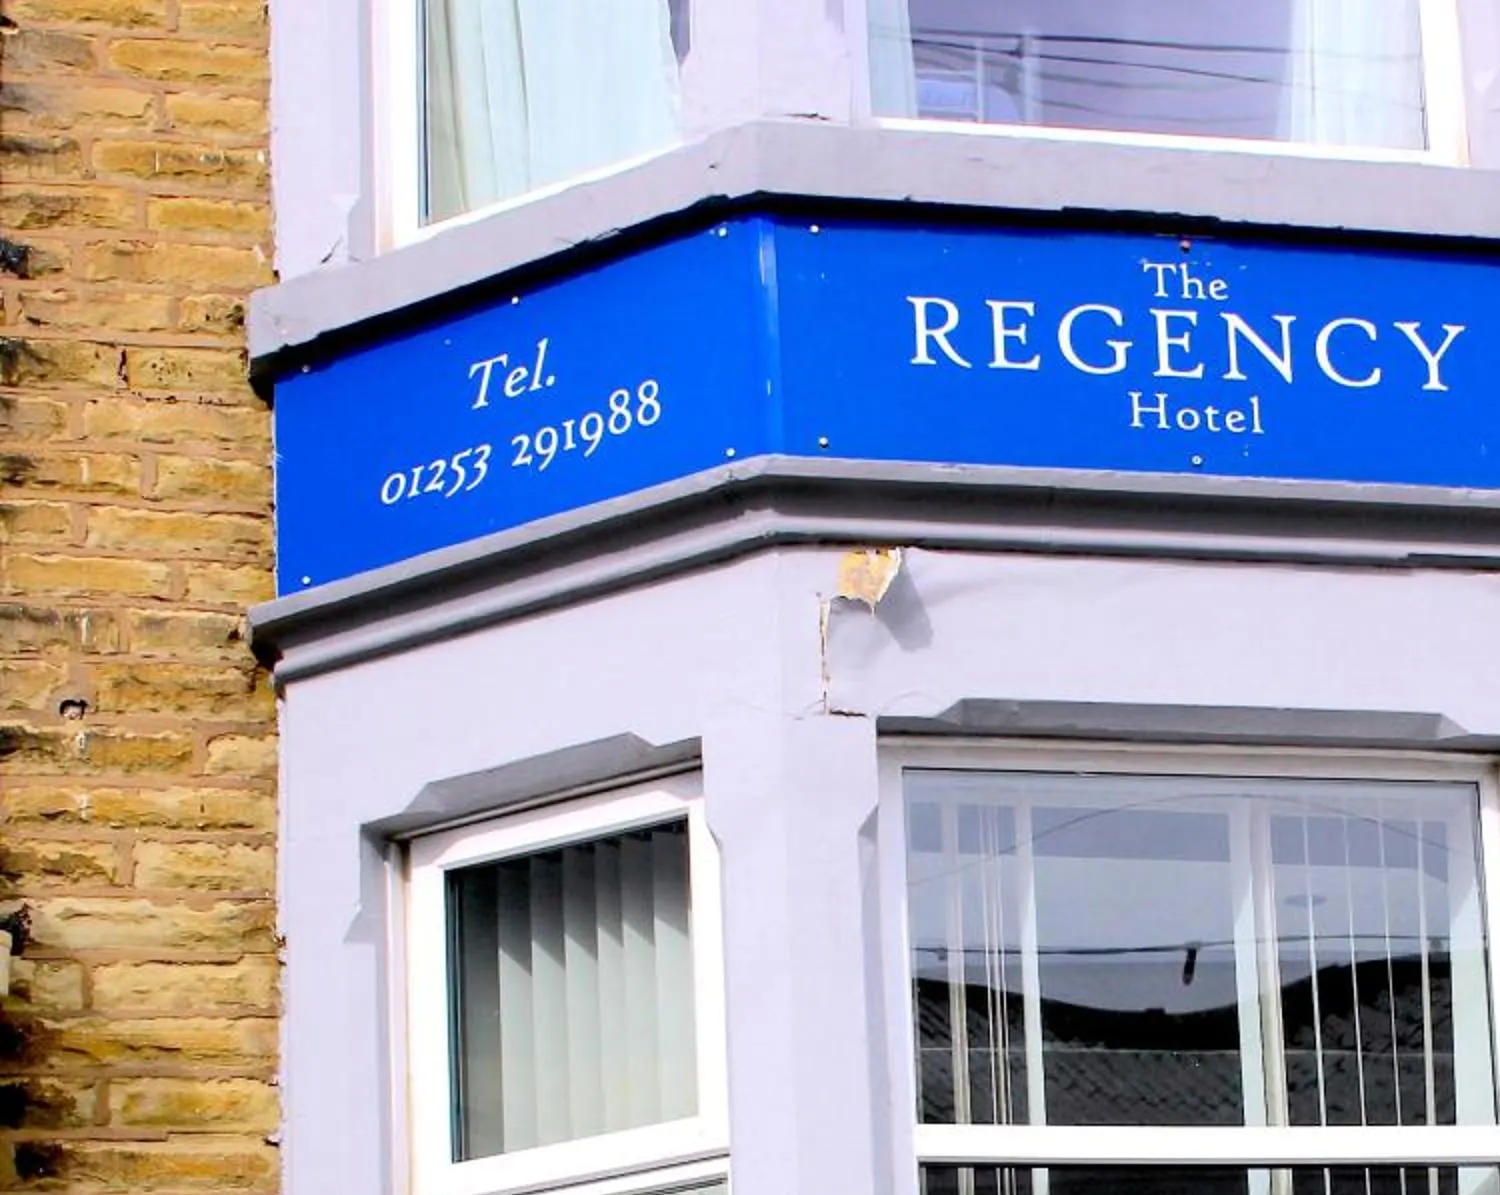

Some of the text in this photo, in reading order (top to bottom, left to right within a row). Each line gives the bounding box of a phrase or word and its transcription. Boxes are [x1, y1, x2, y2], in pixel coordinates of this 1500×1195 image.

[1143, 261, 1228, 300] The
[469, 338, 555, 409] Tel.
[906, 296, 1465, 391] REGENCY
[381, 379, 661, 505] 01253 291988
[1128, 391, 1263, 433] Hotel
